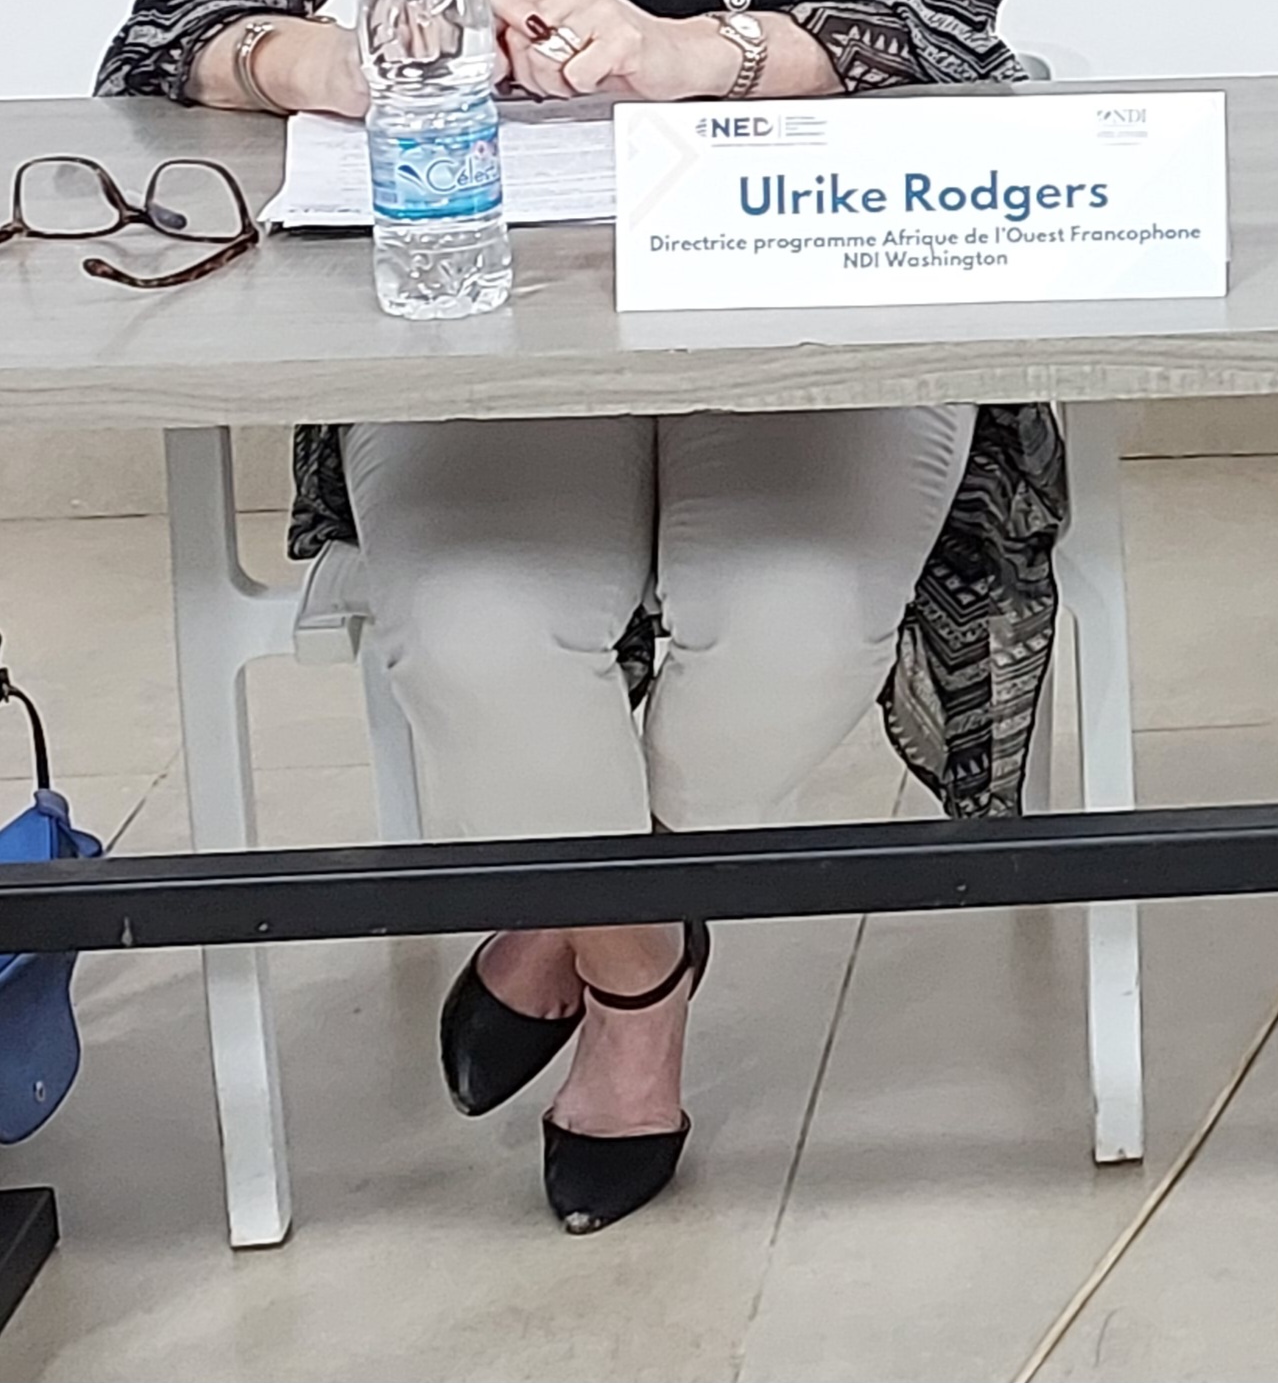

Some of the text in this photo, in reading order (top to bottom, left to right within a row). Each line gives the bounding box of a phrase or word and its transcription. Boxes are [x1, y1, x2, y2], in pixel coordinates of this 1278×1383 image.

[711, 116, 774, 138] NED
[739, 169, 1110, 223] Ulrike Rodgers
[650, 222, 1202, 259] Directrice programme Afrique de l'Ouest Francophone
[843, 249, 1008, 271] NDI Washington
